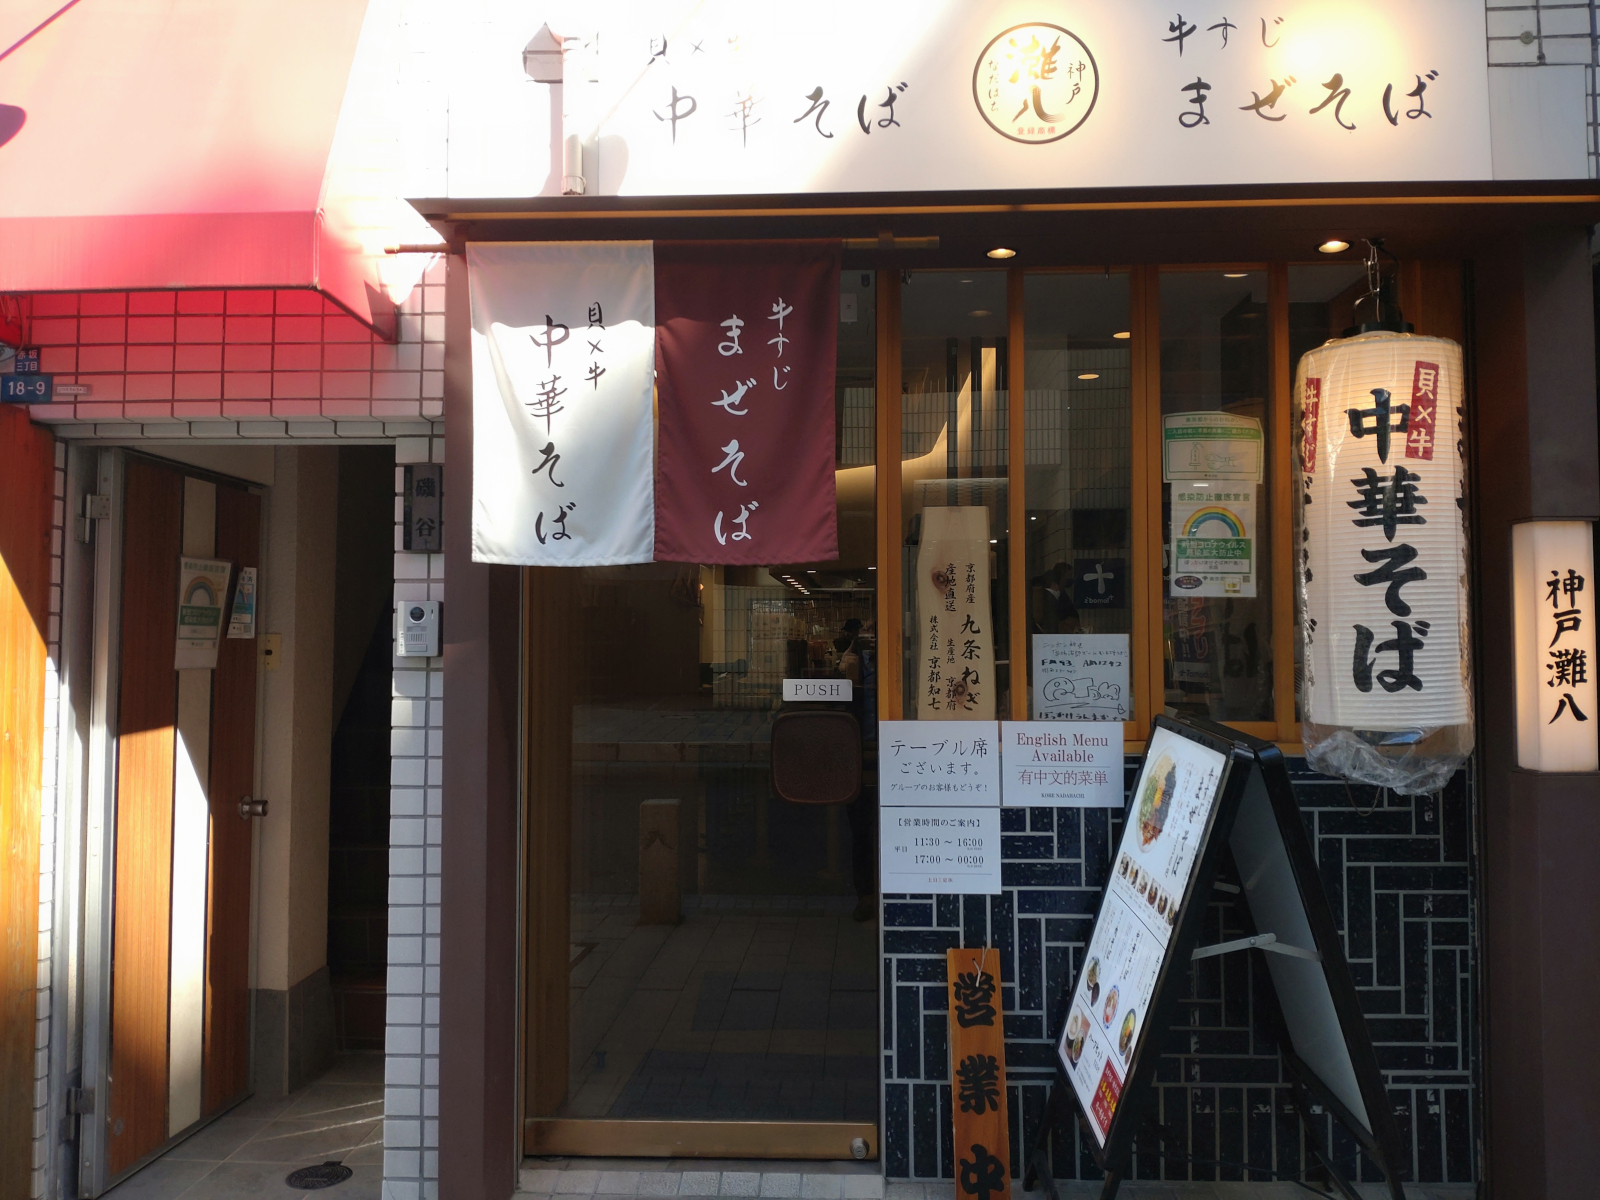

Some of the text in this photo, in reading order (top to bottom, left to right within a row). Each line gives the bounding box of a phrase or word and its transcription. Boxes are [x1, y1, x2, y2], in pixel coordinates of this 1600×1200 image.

[1162, 13, 1284, 57] 牛すじ
[1066, 60, 1086, 105] 神戸
[1178, 70, 1440, 130] まぜそば
[652, 81, 908, 148] 中華そば
[17, 350, 38, 360] 赤坂
[584, 301, 606, 391] 貝×牛
[767, 297, 793, 391] 牛すじ
[16, 361, 38, 371] 三丁目
[8, 381, 46, 396] 18-9
[524, 314, 577, 545] 中華そば
[711, 314, 759, 545] まぜそば
[1407, 367, 1437, 459] 貝×牛
[1177, 492, 1251, 502] 感染防止徹底宣言
[1181, 540, 1247, 549] 新型コロナウイルス
[1345, 387, 1432, 694] 中華そば
[945, 562, 957, 612] 産地直送
[929, 615, 939, 651] 株式会社
[1546, 569, 1588, 725] 神戸灘八
[960, 614, 981, 712] 九条ねぎ
[794, 684, 840, 696] PUSH
[927, 656, 941, 711] 京都知七
[945, 676, 957, 711] 京都府
[890, 737, 988, 759] テーブル席
[1016, 732, 1109, 748] English Menu
[1031, 749, 1094, 763] Available
[900, 761, 979, 775] ございます。
[897, 817, 981, 828] 【営業時間のご案内】
[894, 845, 908, 853] 平日
[914, 837, 940, 847] 11:30
[957, 837, 984, 847] 16:00
[914, 855, 941, 865] 17:00
[957, 855, 984, 865] 00:00
[953, 972, 1006, 1200] 営業中
